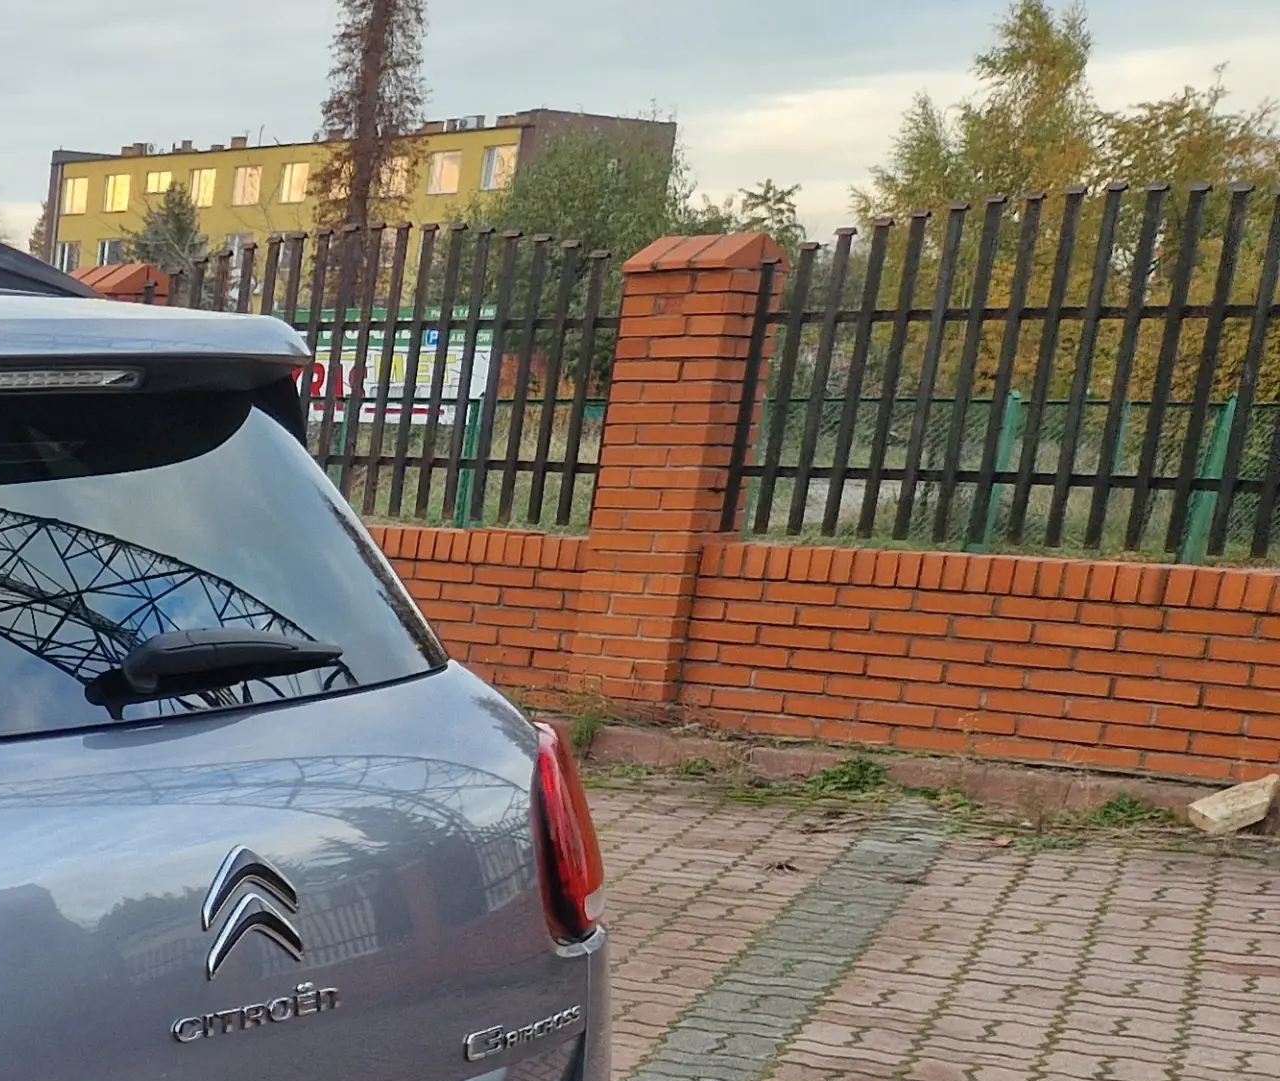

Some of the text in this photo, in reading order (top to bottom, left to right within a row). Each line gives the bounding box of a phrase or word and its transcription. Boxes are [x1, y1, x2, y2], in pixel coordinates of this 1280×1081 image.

[170, 981, 342, 1043] CITROËN
[462, 1004, 582, 1062] C3 AIRCROSS
